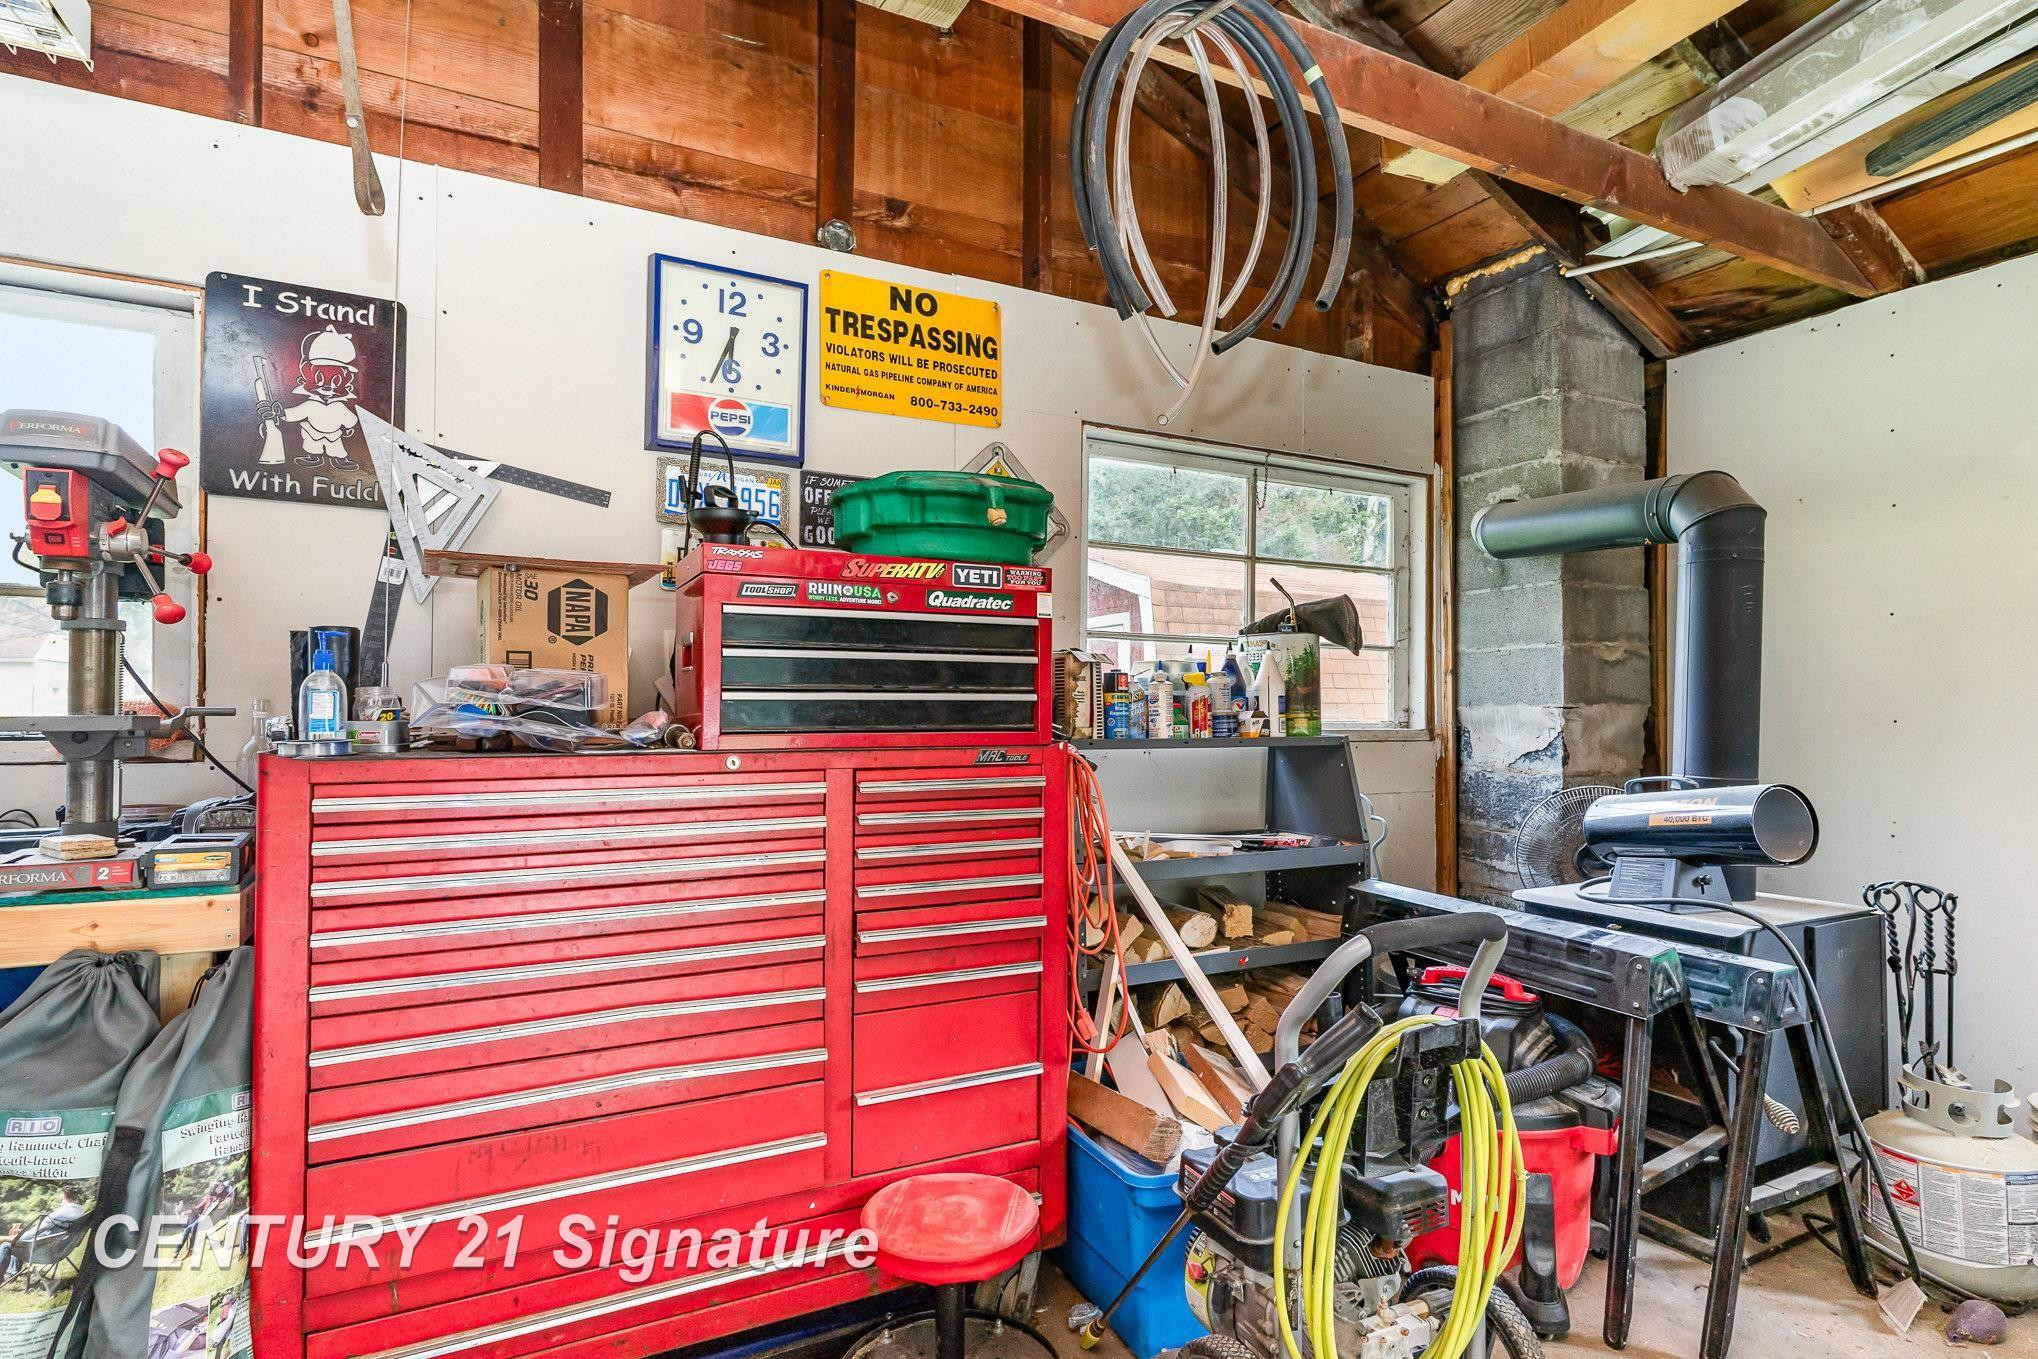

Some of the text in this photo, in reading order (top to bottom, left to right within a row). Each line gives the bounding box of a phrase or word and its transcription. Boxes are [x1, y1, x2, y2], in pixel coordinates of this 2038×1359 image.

[243, 284, 375, 327] I Stand
[718, 288, 747, 318] 12
[889, 285, 938, 317] NO
[682, 318, 703, 344] 9
[825, 306, 998, 361] TRESPASSING
[761, 332, 780, 358] 3
[825, 342, 998, 380] VIOLATORS WILL BE PROSECUTED
[721, 359, 742, 385] 6
[825, 362, 998, 396] NATURAL GAS PIPELINE COMPANY OF AMERICA
[825, 383, 895, 400] KINDER MORGAN
[910, 395, 998, 417] 800-733-2490
[710, 410, 752, 425] PEPSI
[228, 468, 380, 502] With Fudd
[804, 475, 855, 488] IF SOME
[804, 486, 833, 506] OFF
[810, 506, 835, 517] PLEA
[803, 524, 836, 546] GOO
[711, 546, 764, 559] TRAXXAS
[707, 559, 743, 572] JEGS
[1009, 569, 1042, 577] WARNING
[956, 568, 999, 585] YETI
[515, 572, 523, 612] MOTOR OIL
[524, 579, 539, 602] 30
[744, 584, 793, 597] TOOL SHOP
[928, 591, 1012, 610] Quadratec
[565, 590, 591, 633] NAPA
[976, 750, 1006, 762] MAC
[97, 866, 110, 880] 2
[10, 1120, 57, 1133] RIO
[180, 1119, 234, 1139] Swinging
[9, 1138, 73, 1152] Hammock
[77, 1135, 109, 1150] Chai
